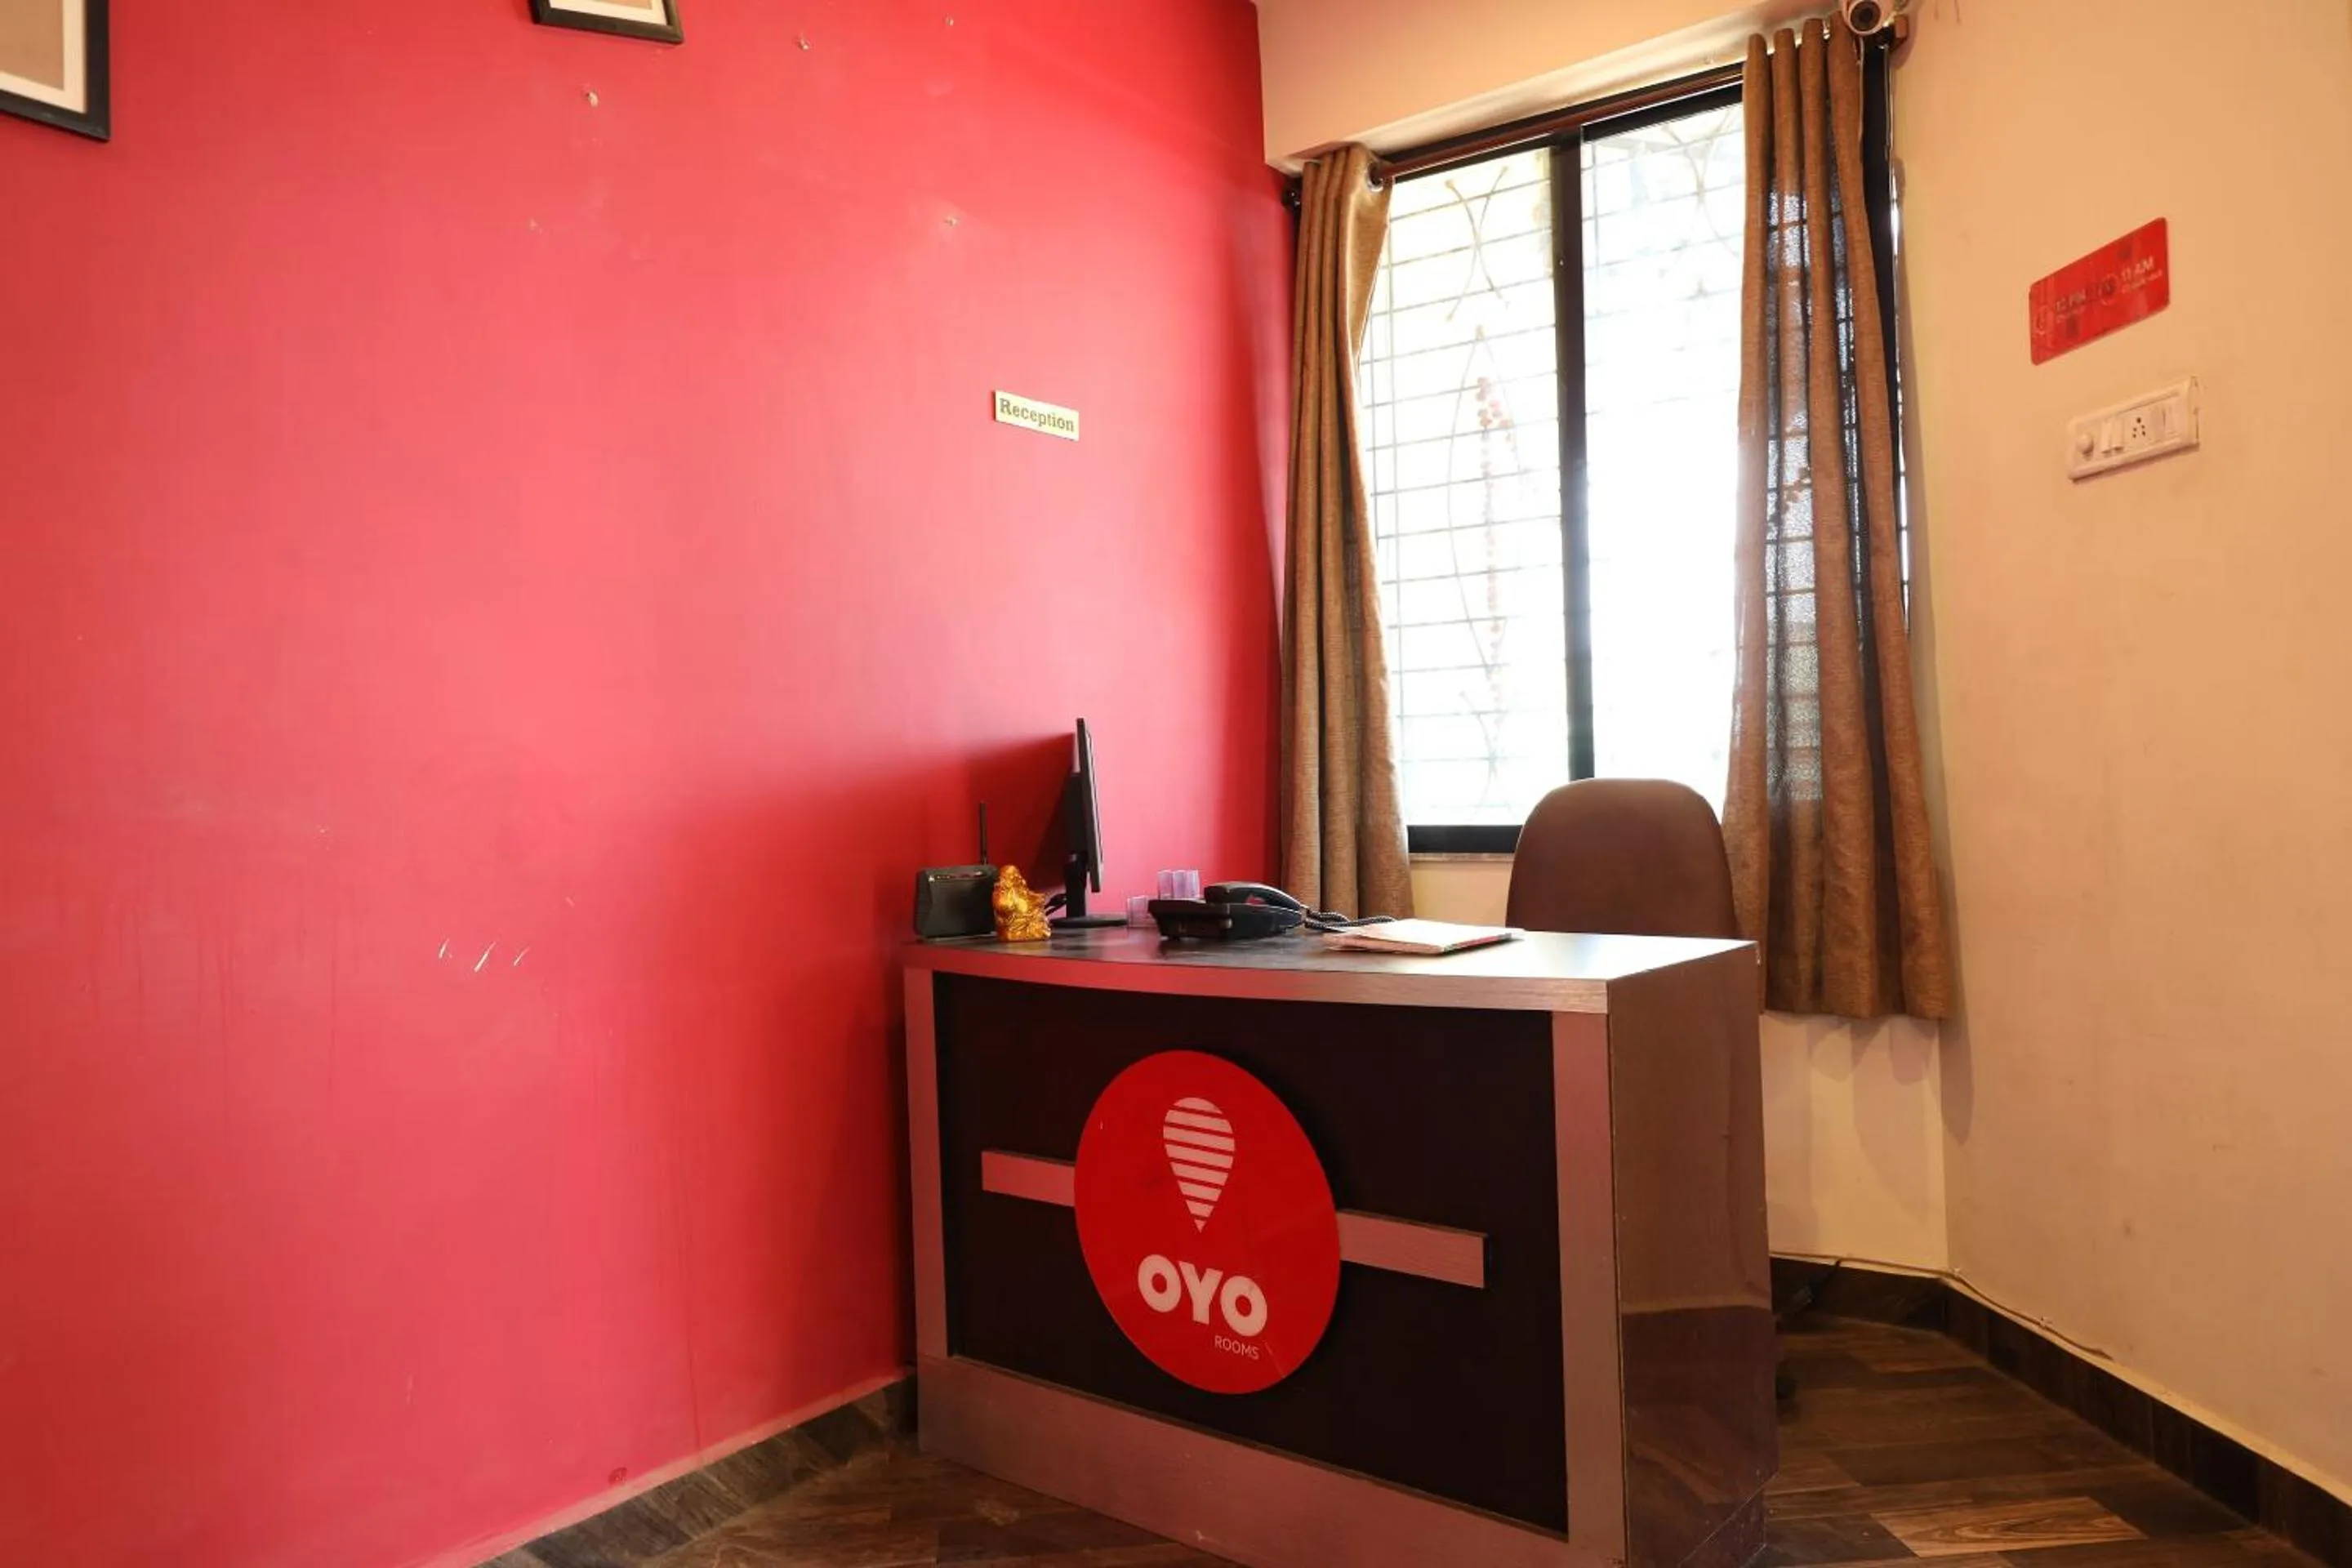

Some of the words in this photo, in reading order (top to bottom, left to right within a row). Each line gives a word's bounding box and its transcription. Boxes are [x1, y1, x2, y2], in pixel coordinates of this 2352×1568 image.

[1000, 398, 1075, 432] Reception
[1138, 1254, 1267, 1337] OYO
[1214, 1335, 1259, 1360] ROOMS
